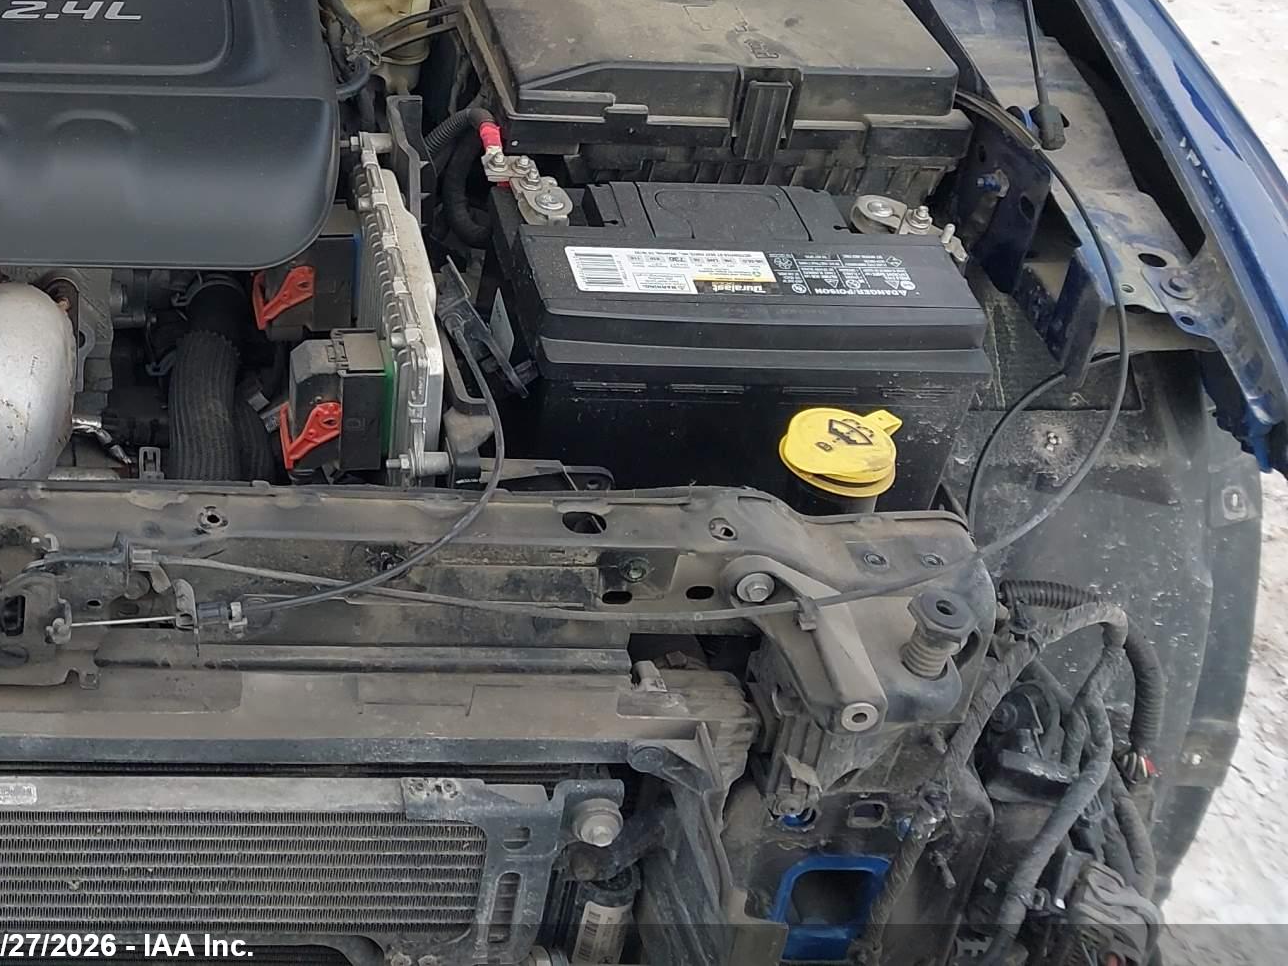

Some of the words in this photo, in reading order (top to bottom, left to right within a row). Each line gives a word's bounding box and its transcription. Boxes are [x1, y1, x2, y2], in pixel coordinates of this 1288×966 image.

[1, 0, 142, 20] 2.4L
[711, 283, 767, 294] Duralast
[814, 287, 899, 296] DANGER/POISON
